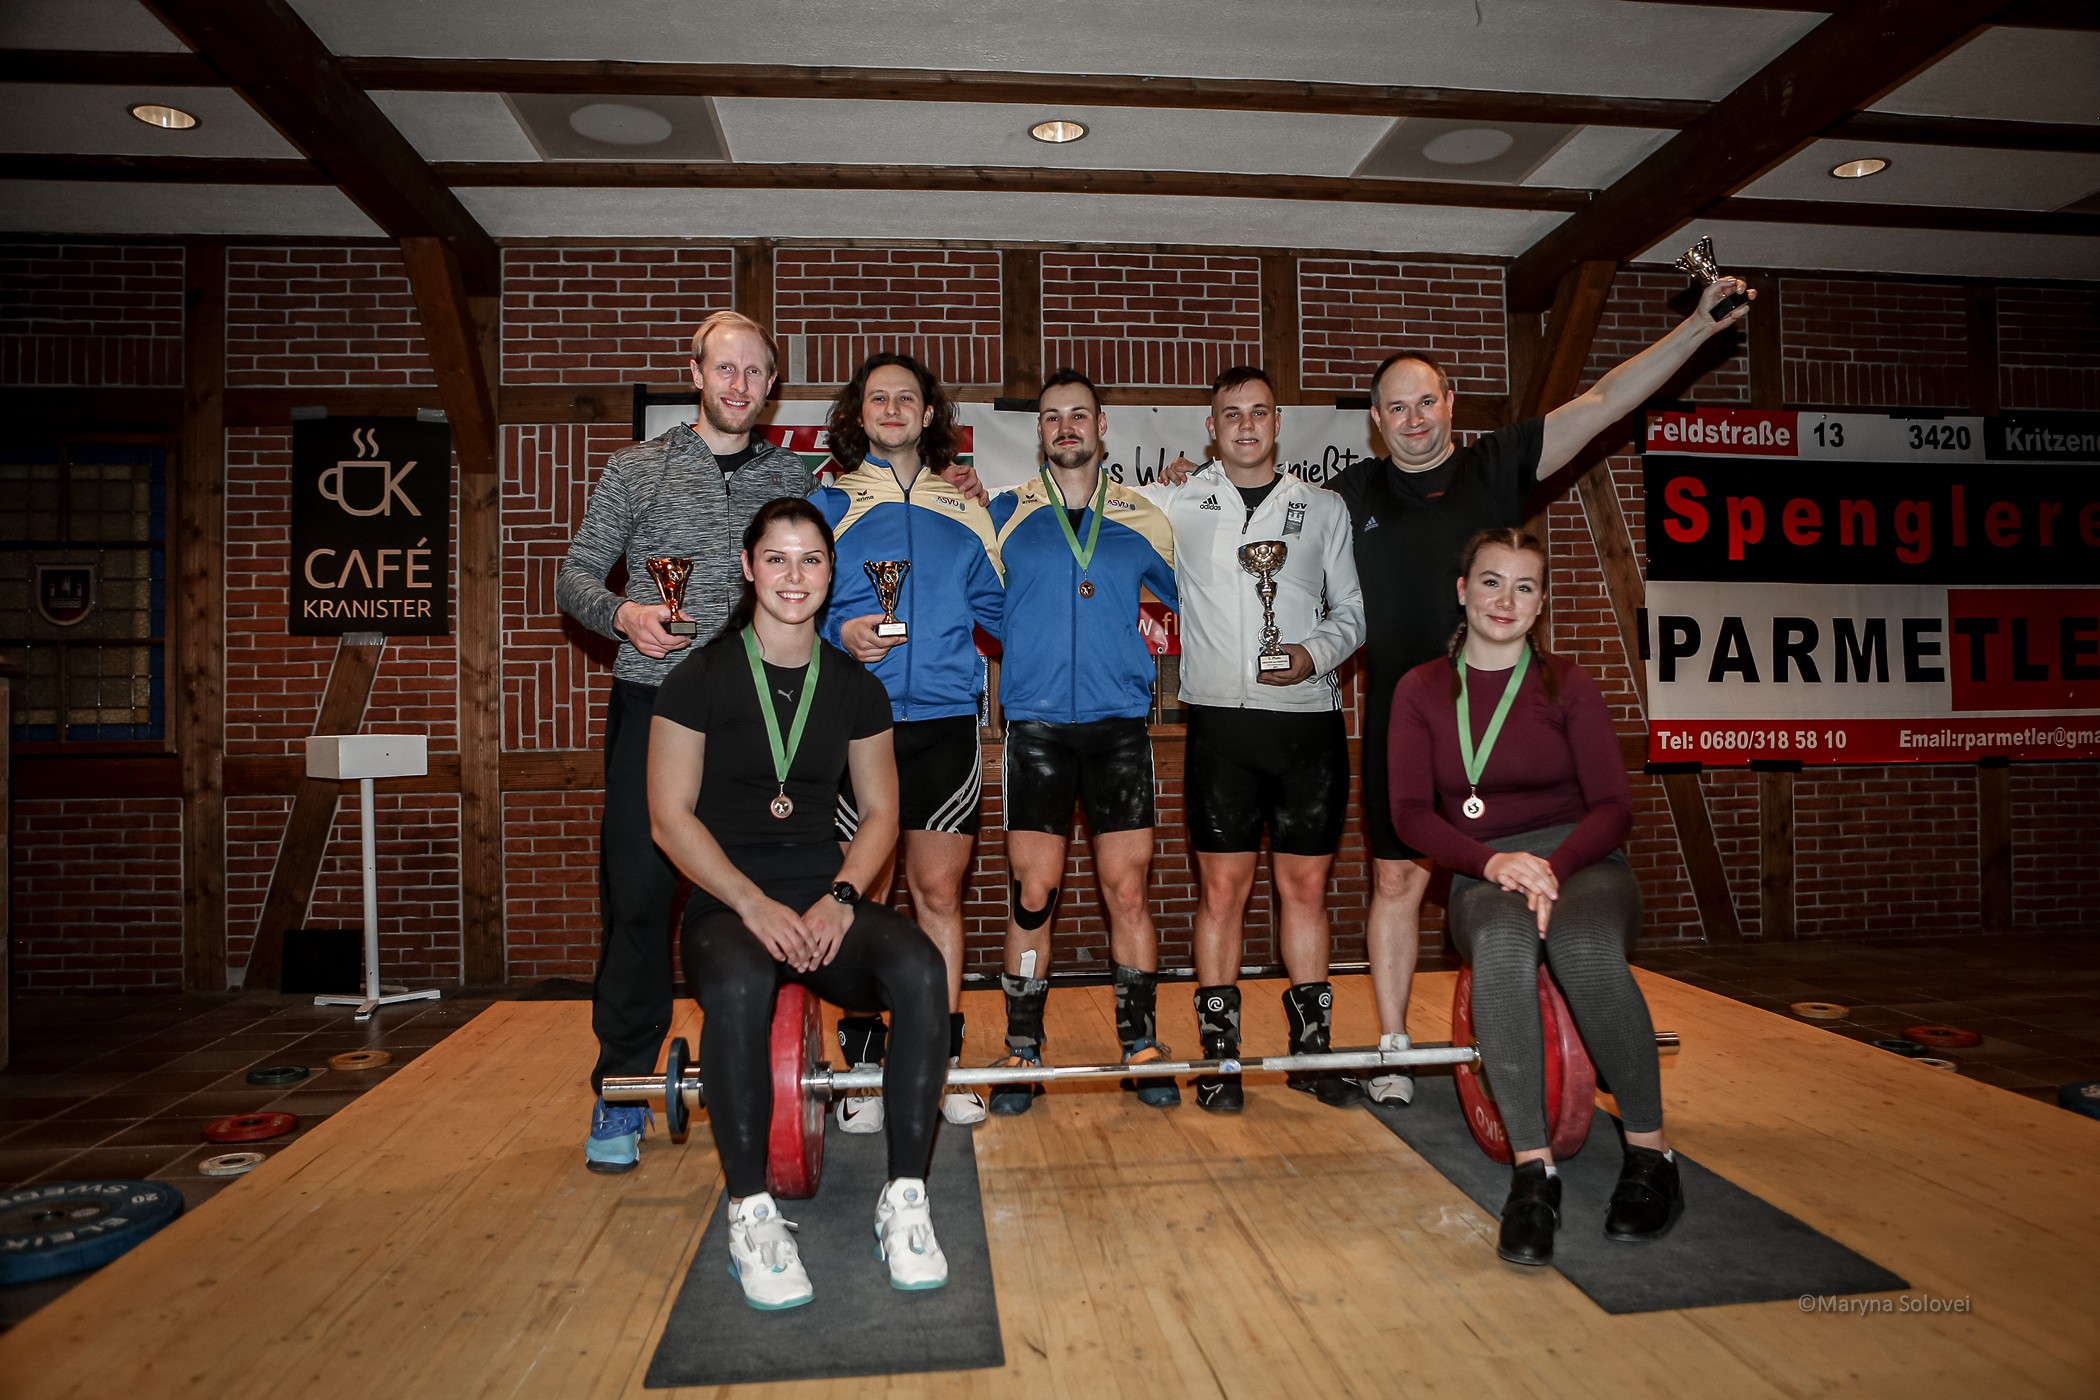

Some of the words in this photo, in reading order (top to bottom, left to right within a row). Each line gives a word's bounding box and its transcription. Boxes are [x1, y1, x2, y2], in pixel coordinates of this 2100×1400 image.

[1647, 416, 1791, 446] Feldstraße
[1813, 422, 1845, 448] 13
[1909, 424, 1971, 450] 3420
[1199, 503, 1222, 511] adidas
[304, 536, 433, 589] CAFÉ
[303, 599, 432, 618] KRANISTER
[1657, 615, 2100, 684] PARMETLE
[1657, 731, 1694, 750] Tel:
[1699, 730, 1790, 750] 0680/318
[1795, 730, 1818, 749] 58
[1824, 730, 1847, 749] 10
